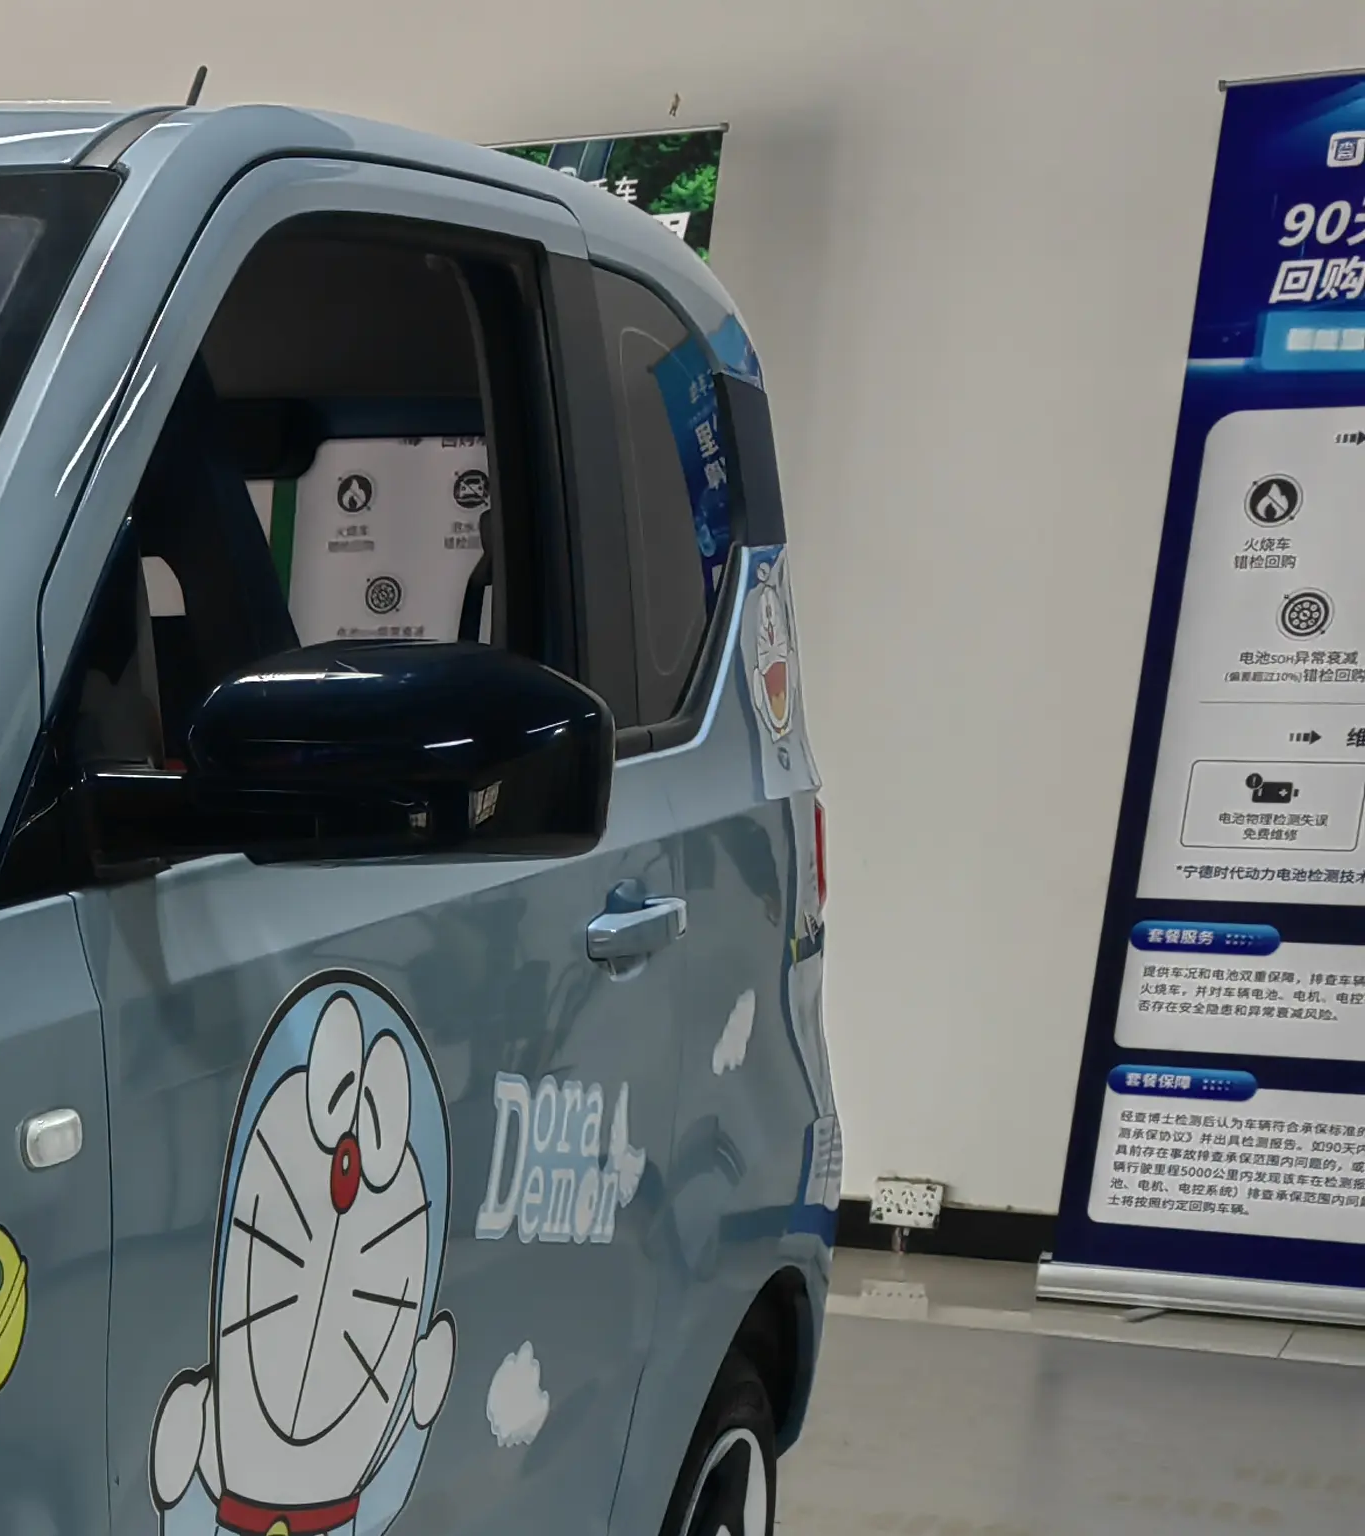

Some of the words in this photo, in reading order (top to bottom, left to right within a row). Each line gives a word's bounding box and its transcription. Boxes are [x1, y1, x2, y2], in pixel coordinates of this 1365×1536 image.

[1243, 537, 1291, 552] 火烧车
[1219, 813, 1329, 827] 电池物理检测失误
[1243, 828, 1298, 842] 免费维修
[1147, 928, 1215, 946] 套餐服务
[1125, 1072, 1192, 1090] 套餐保障
